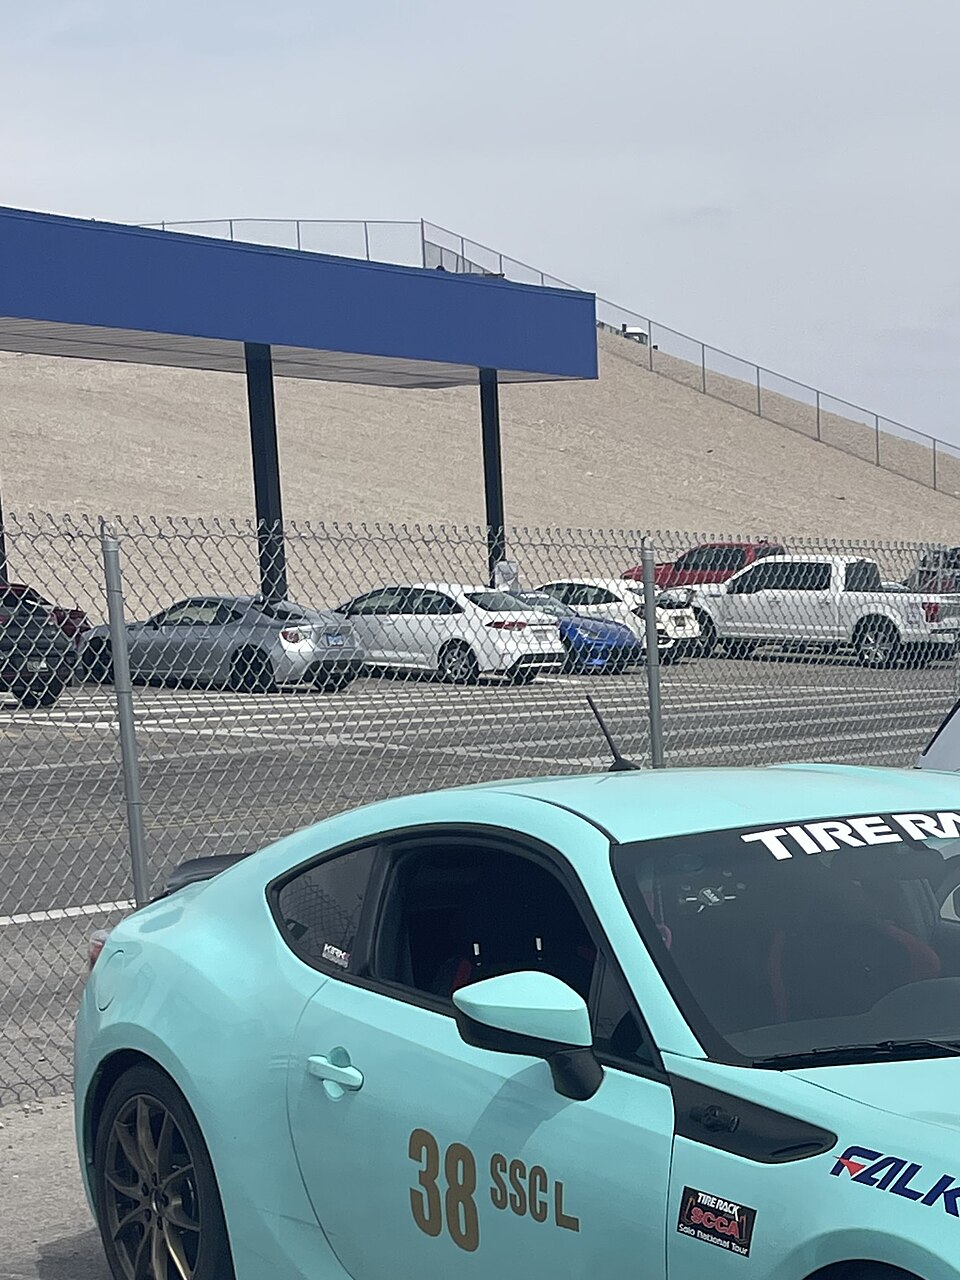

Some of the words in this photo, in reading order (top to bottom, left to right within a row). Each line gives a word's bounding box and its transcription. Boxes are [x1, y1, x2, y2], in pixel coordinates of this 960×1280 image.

[740, 815, 903, 861] TIRE
[408, 1127, 480, 1252] 38
[690, 1206, 740, 1239] SCCA
[698, 1192, 717, 1209] TIRE
[715, 1199, 740, 1221] RACK
[679, 1223, 696, 1236] Solo
[731, 1242, 749, 1255] Tour
